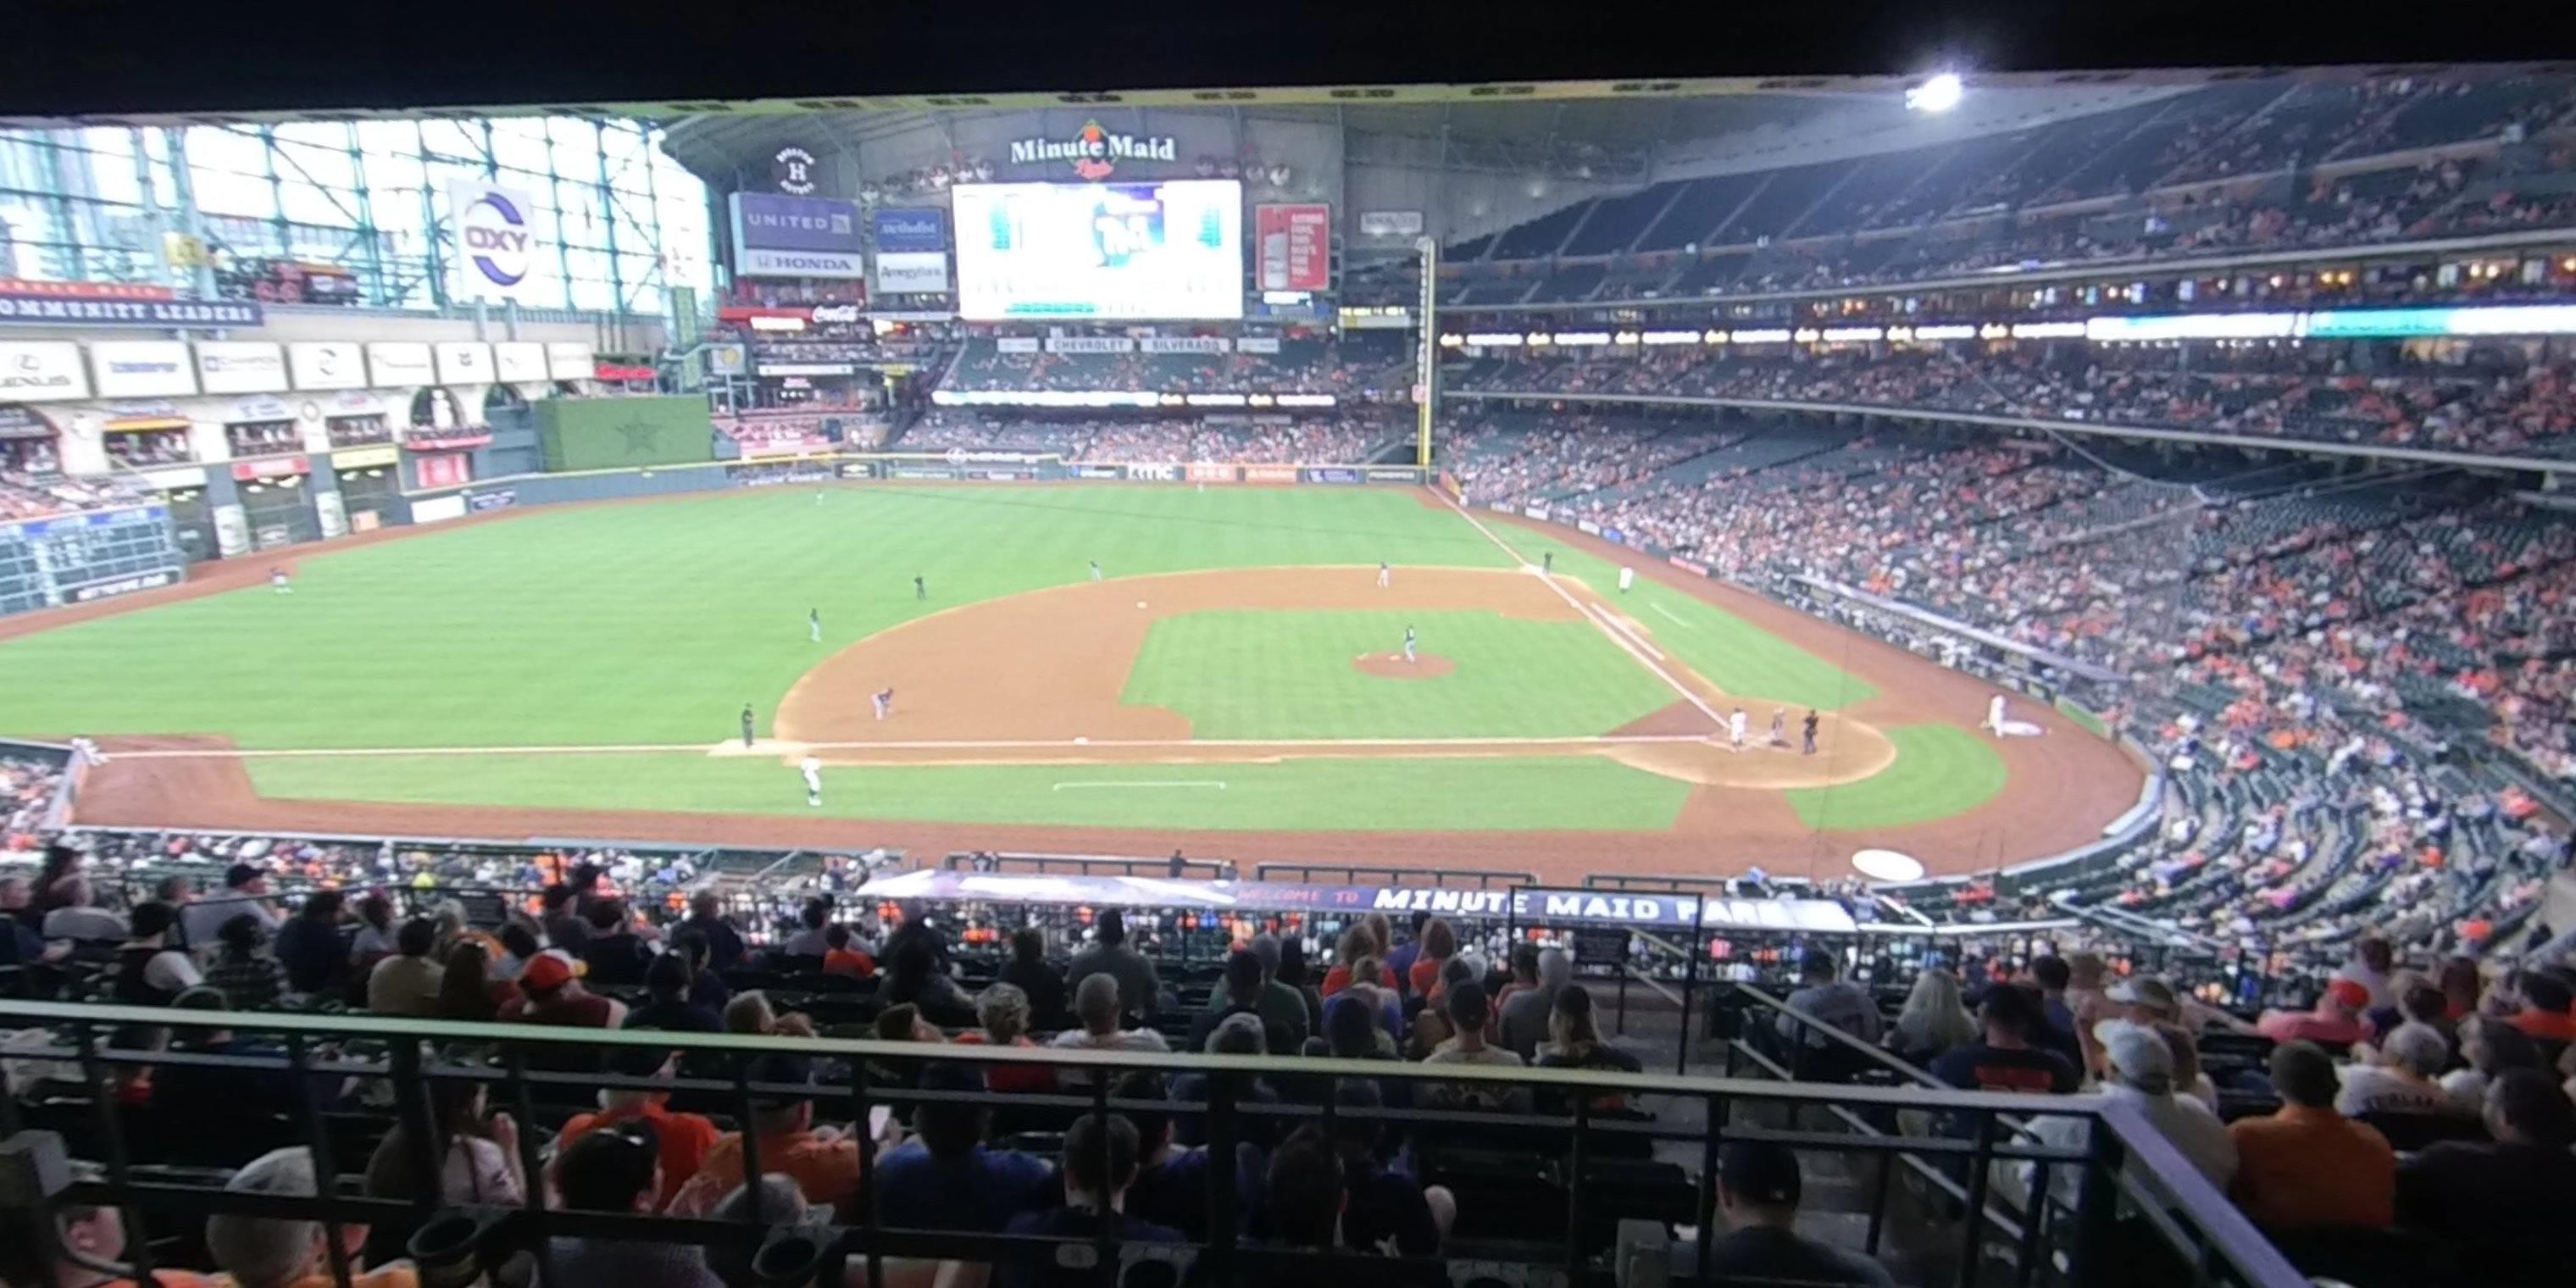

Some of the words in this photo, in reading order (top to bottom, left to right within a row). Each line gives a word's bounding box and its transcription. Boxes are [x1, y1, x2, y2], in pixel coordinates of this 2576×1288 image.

[1011, 136, 1106, 164] Minute
[1108, 136, 1176, 161] Maid
[789, 162, 806, 181] H
[747, 214, 828, 229] UNITED
[465, 225, 527, 253] OXY
[775, 256, 852, 270] HONDA
[0, 299, 145, 319] OMMUNITY
[153, 303, 252, 321] LEADERS
[1053, 341, 1124, 351] CHEVROLET
[1152, 341, 1220, 351] SILVERADO
[0, 375, 71, 387] EXUS
[1334, 891, 1361, 903] TO
[1373, 888, 1530, 913] MINUTE
[1546, 895, 1659, 920] MAID
